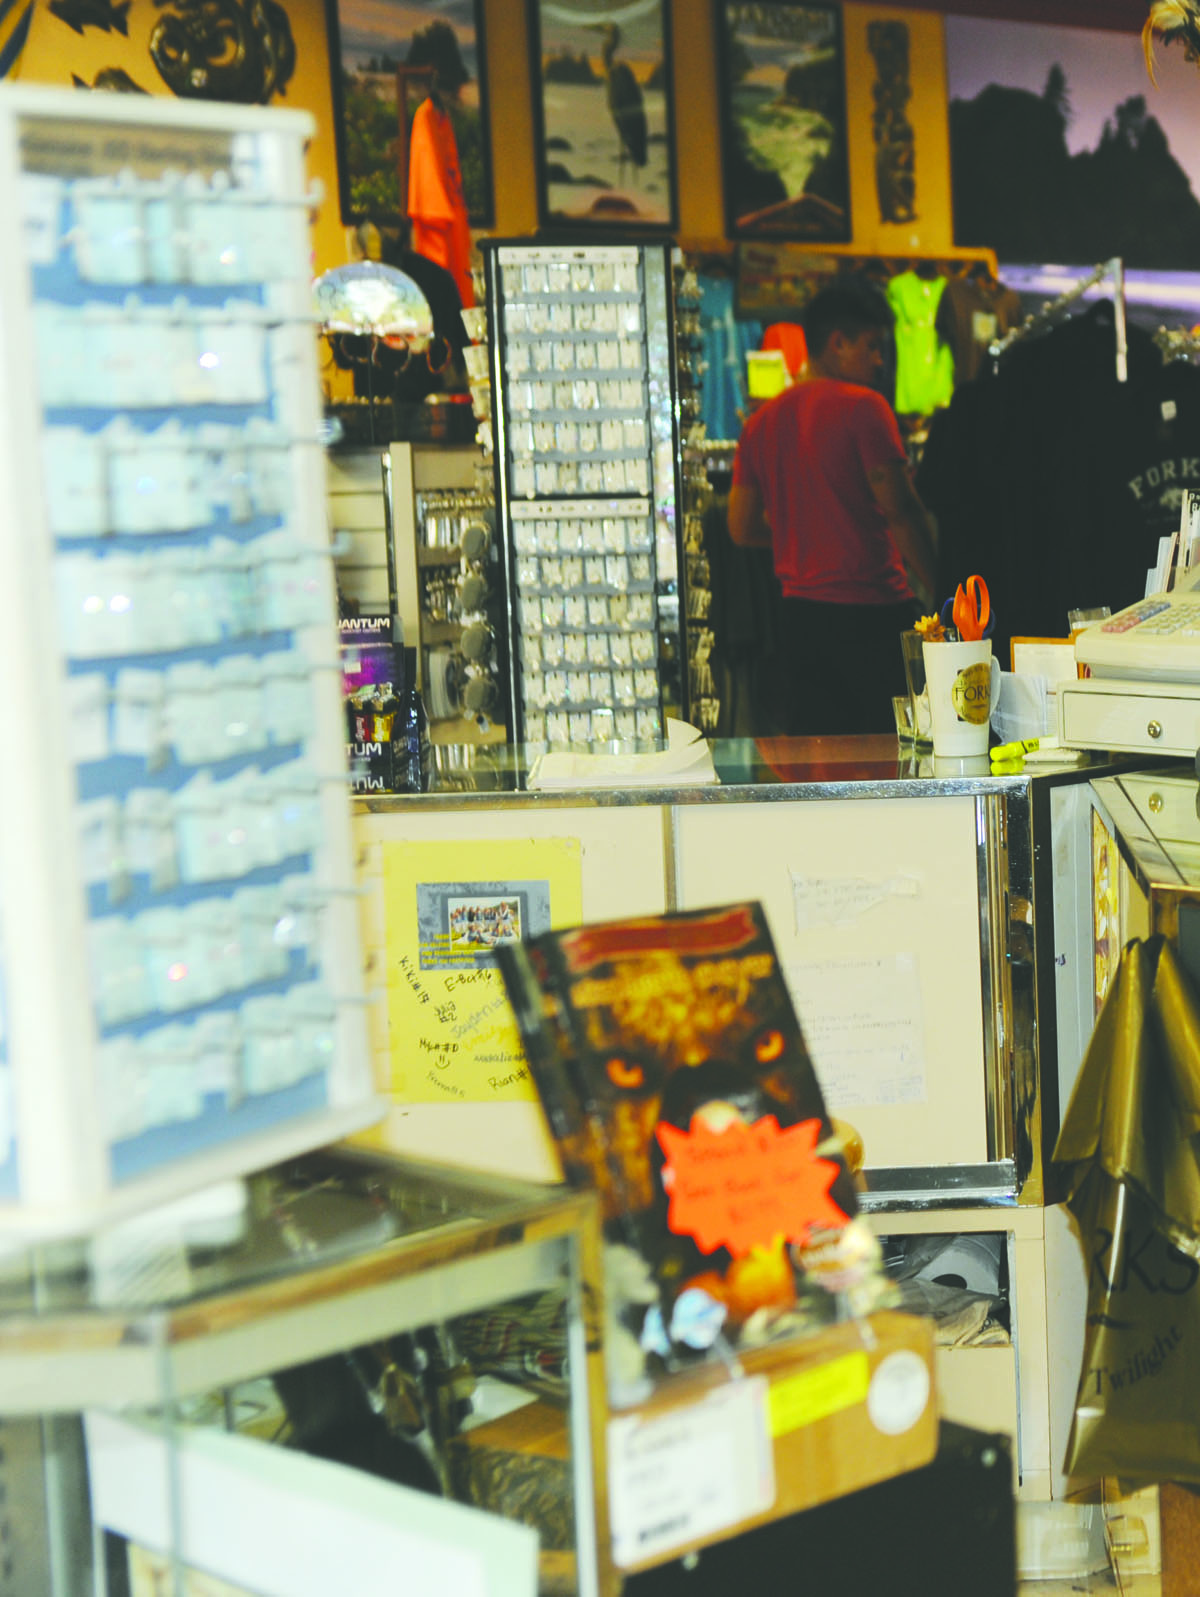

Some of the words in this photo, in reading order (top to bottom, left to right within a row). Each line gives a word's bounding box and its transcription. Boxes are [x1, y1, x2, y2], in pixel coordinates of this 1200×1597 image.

[955, 686, 991, 701] FORK
[1090, 1227, 1200, 1295] RKS
[1089, 1324, 1184, 1396] Twilight
